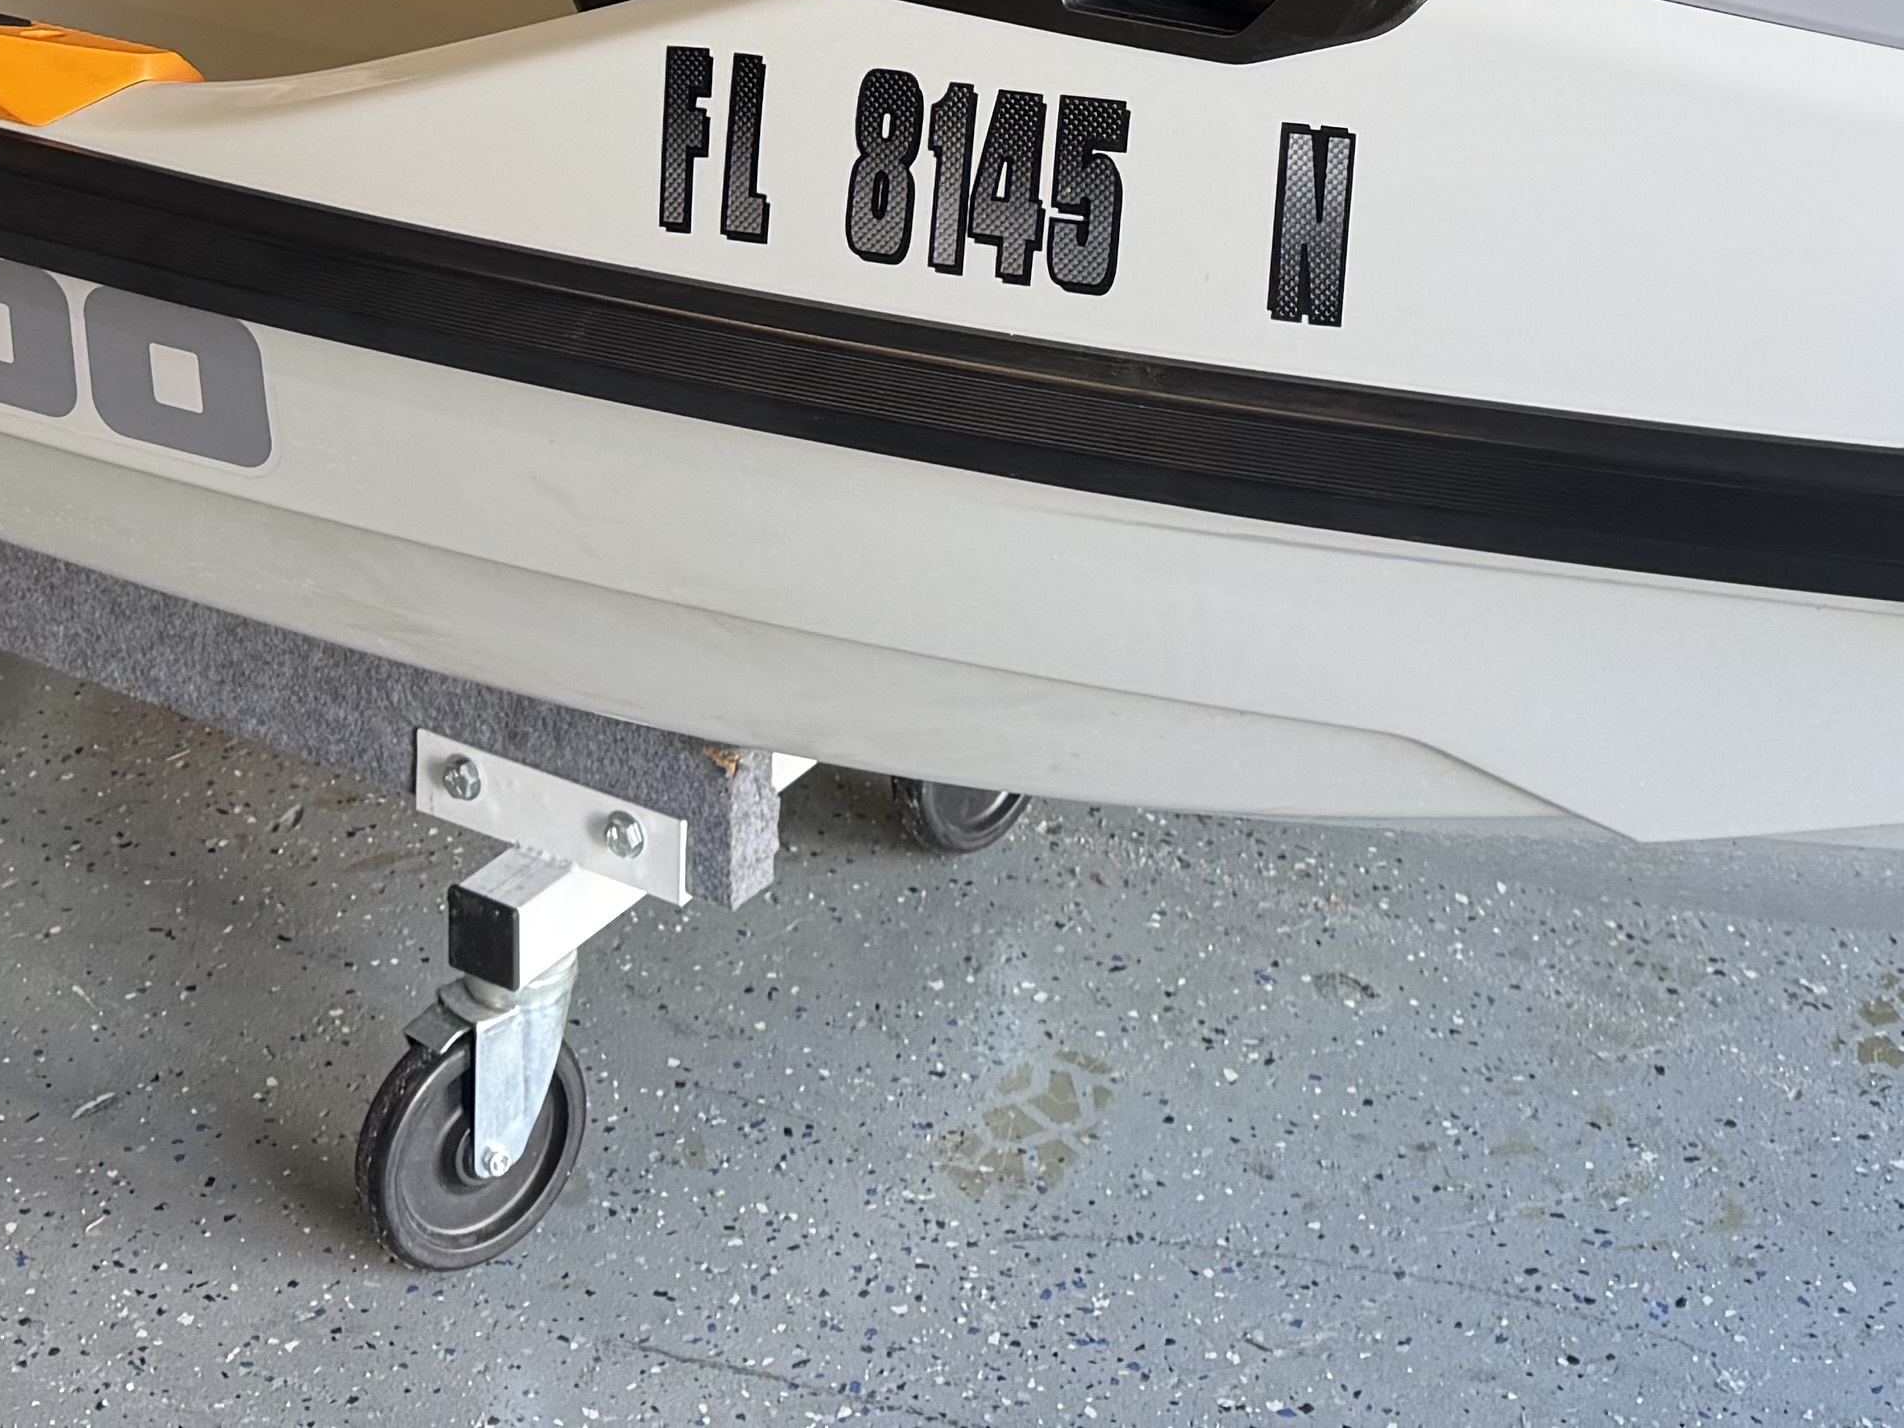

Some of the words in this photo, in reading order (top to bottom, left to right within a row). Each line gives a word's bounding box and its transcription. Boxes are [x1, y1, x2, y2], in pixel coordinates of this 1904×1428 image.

[658, 44, 772, 245] FL
[845, 67, 1131, 296] 8145
[1267, 121, 1356, 328] N
